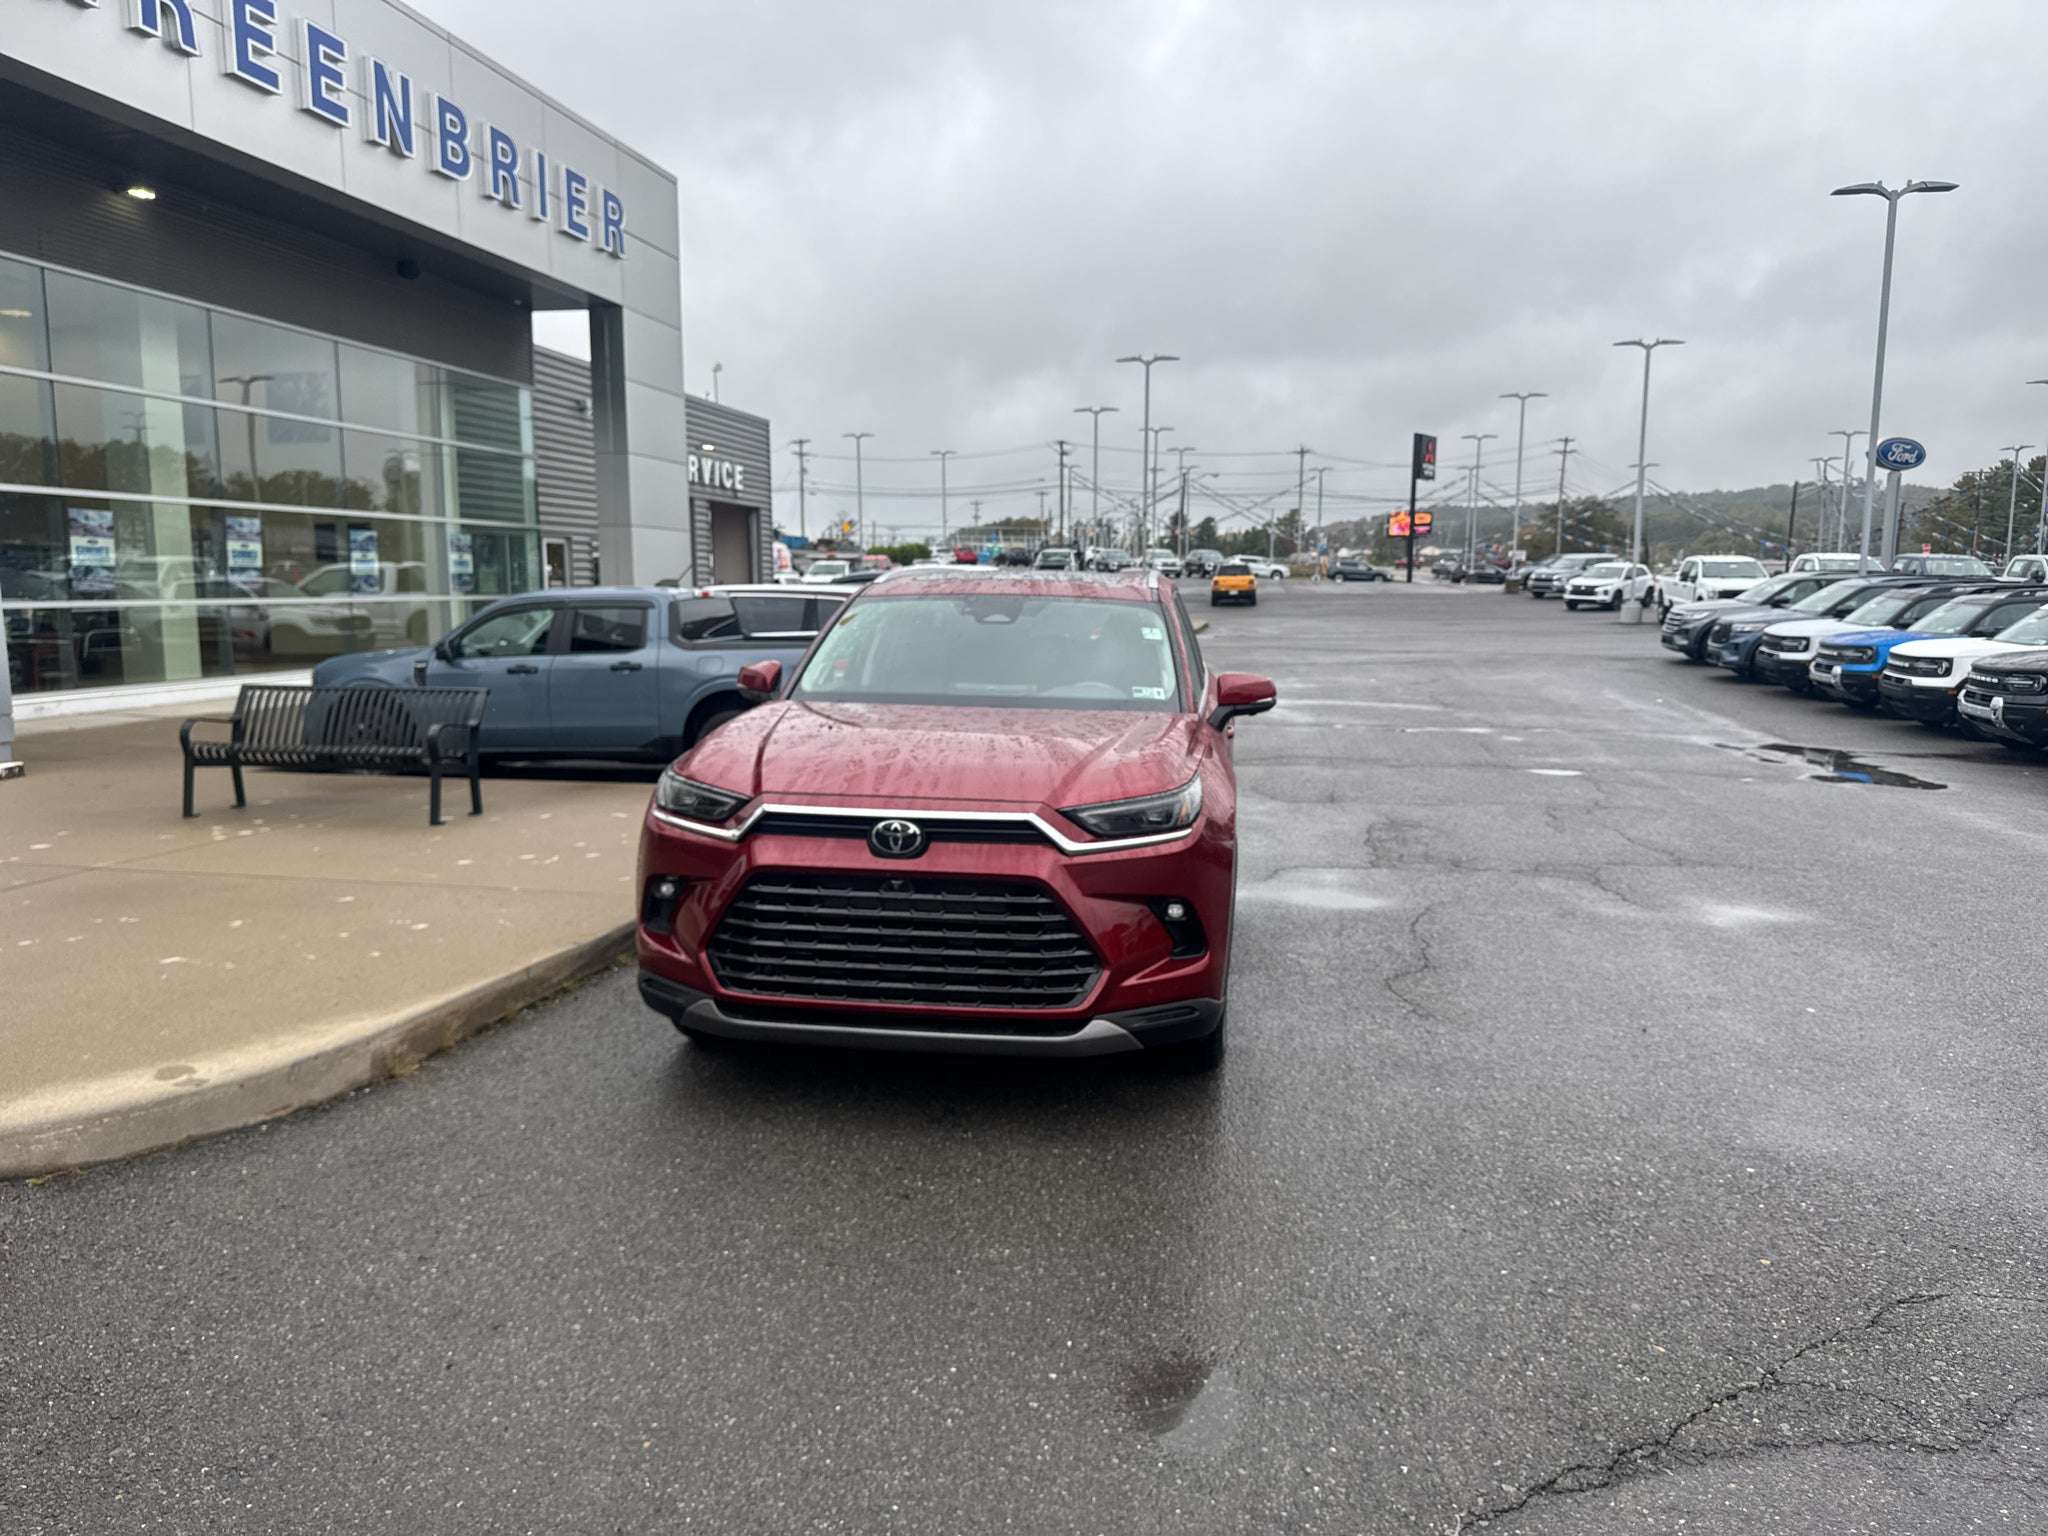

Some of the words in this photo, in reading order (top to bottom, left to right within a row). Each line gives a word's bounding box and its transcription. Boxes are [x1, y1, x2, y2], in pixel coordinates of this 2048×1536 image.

[66, 0, 627, 259] EENBRIER
[1888, 443, 1918, 463] Ford
[688, 454, 744, 490] RVICE
